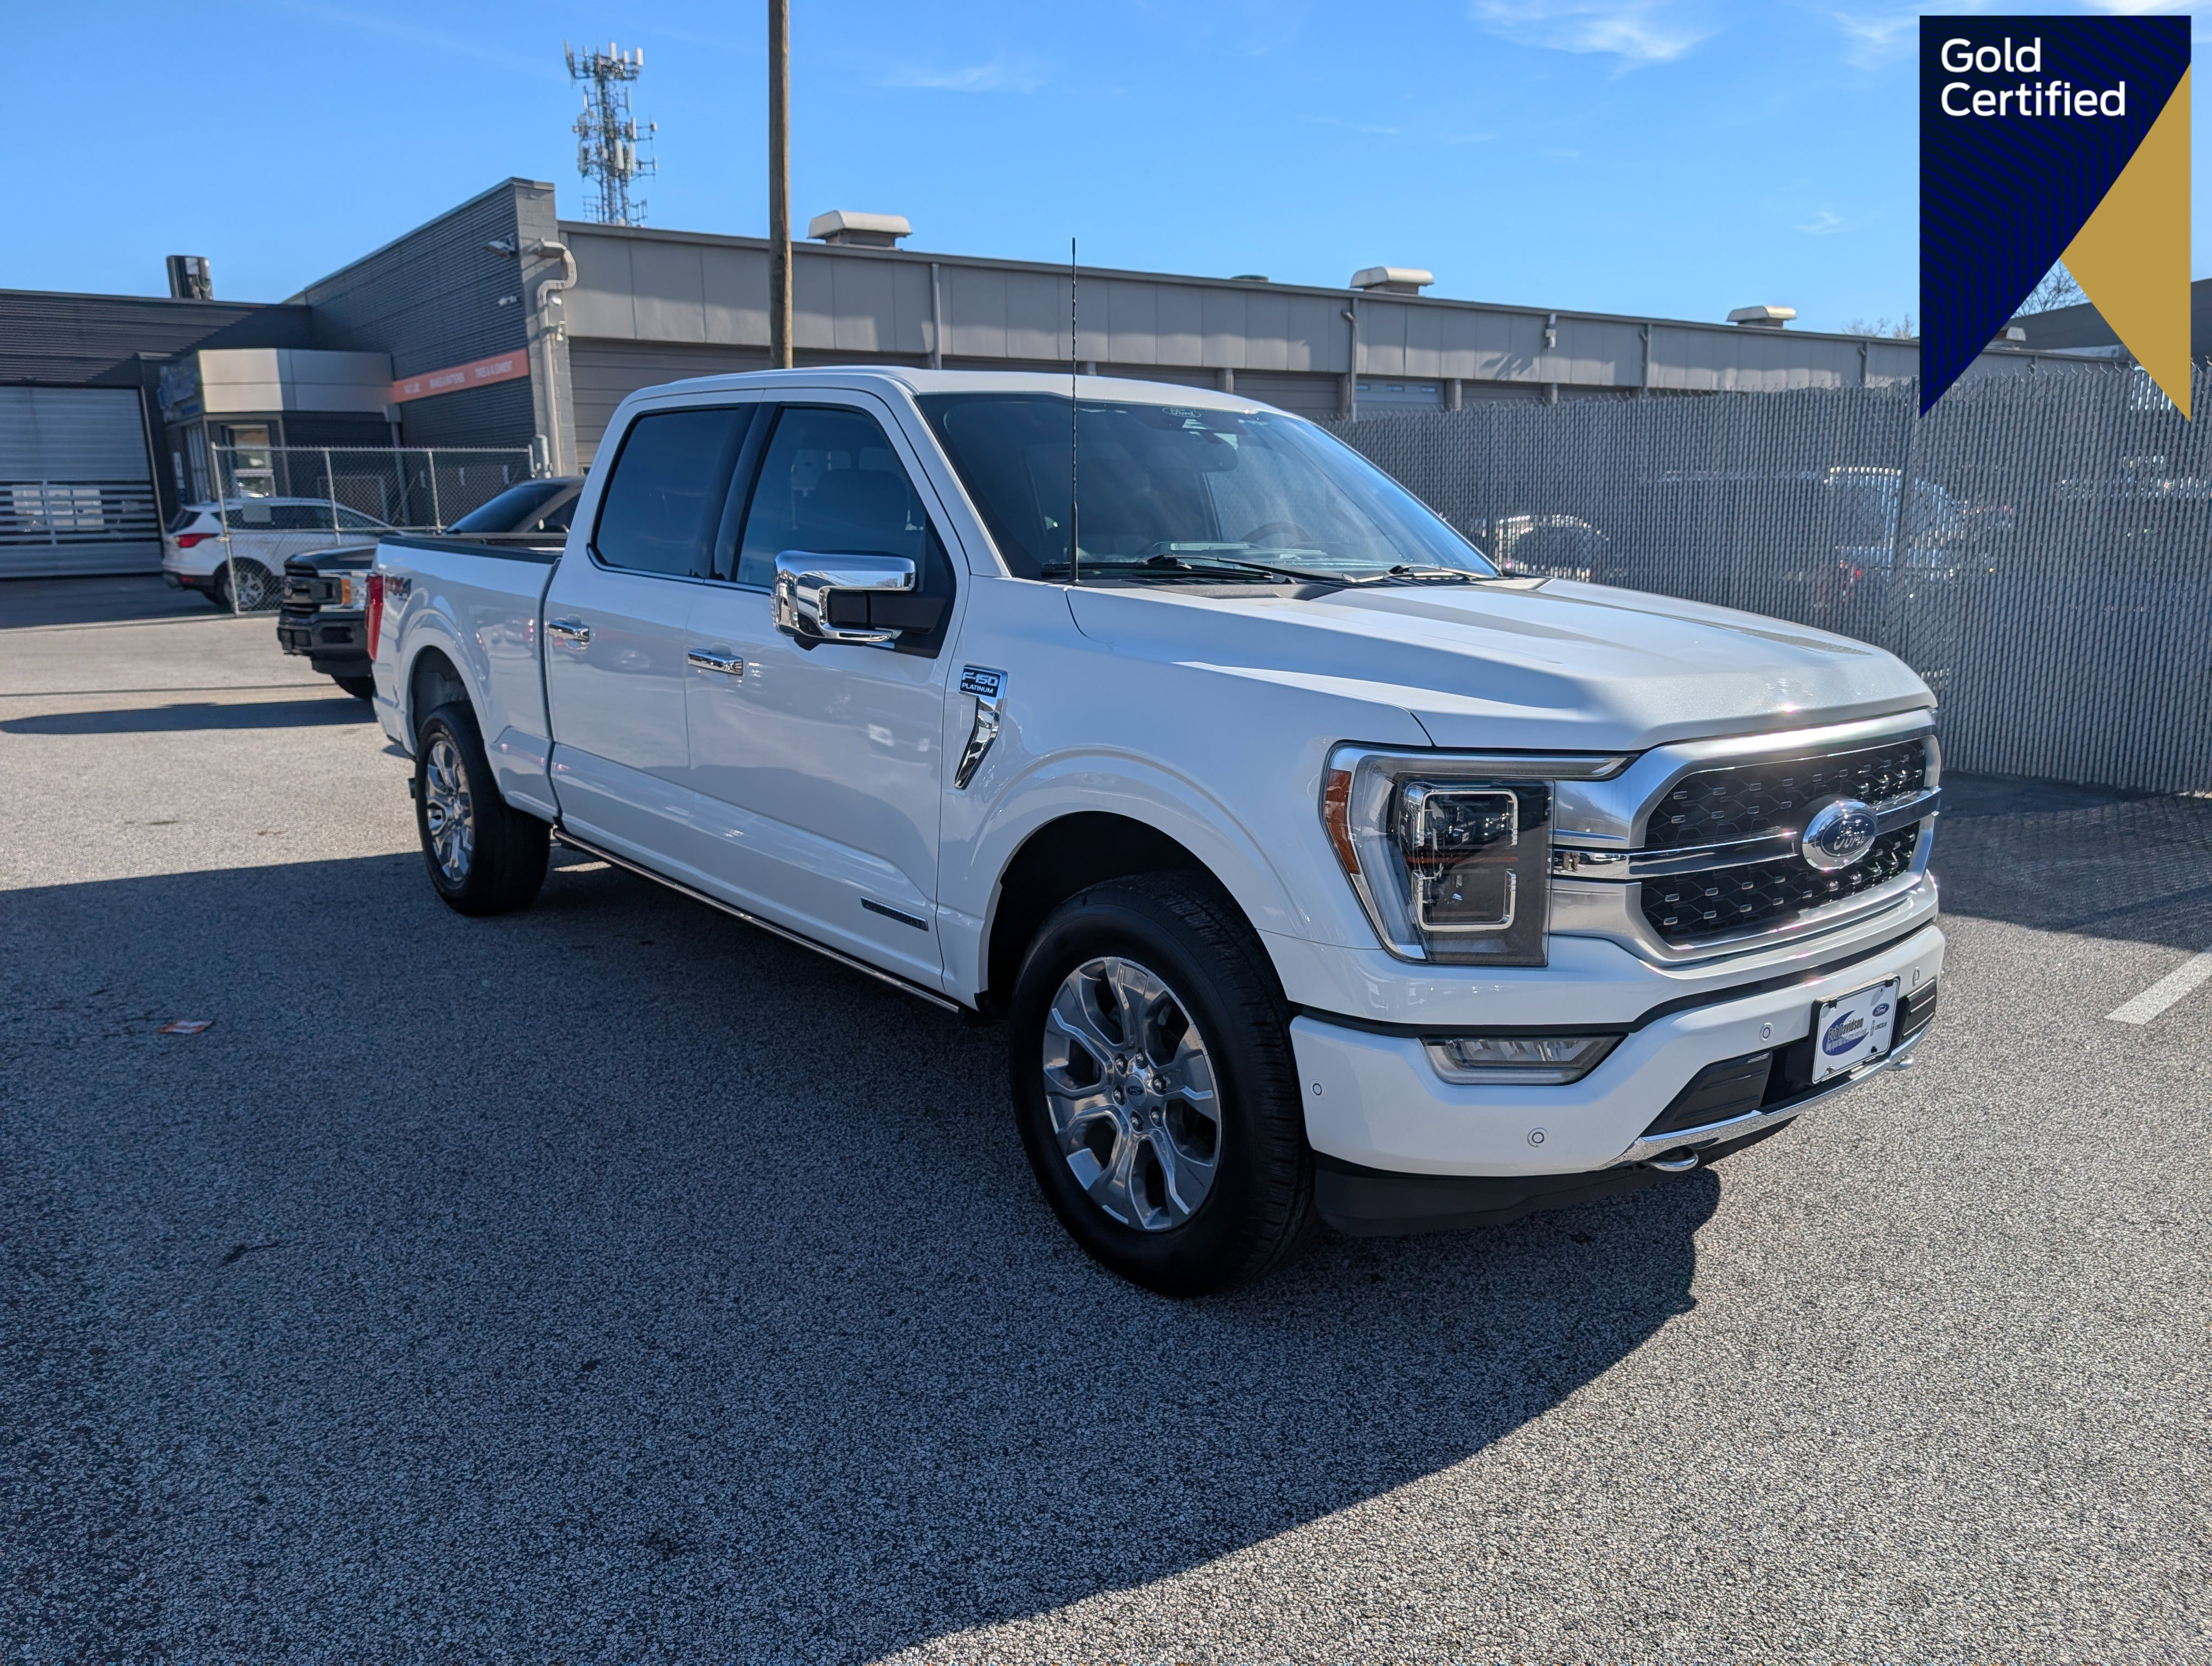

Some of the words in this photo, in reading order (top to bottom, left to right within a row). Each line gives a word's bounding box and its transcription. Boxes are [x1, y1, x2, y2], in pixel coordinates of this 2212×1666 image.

[961, 682, 994, 694] PLATINUM
[962, 671, 999, 687] F-150
[1834, 820, 1868, 851] Ford
[1828, 1024, 1839, 1041] Bob
[1839, 1017, 1864, 1036] Davidson
